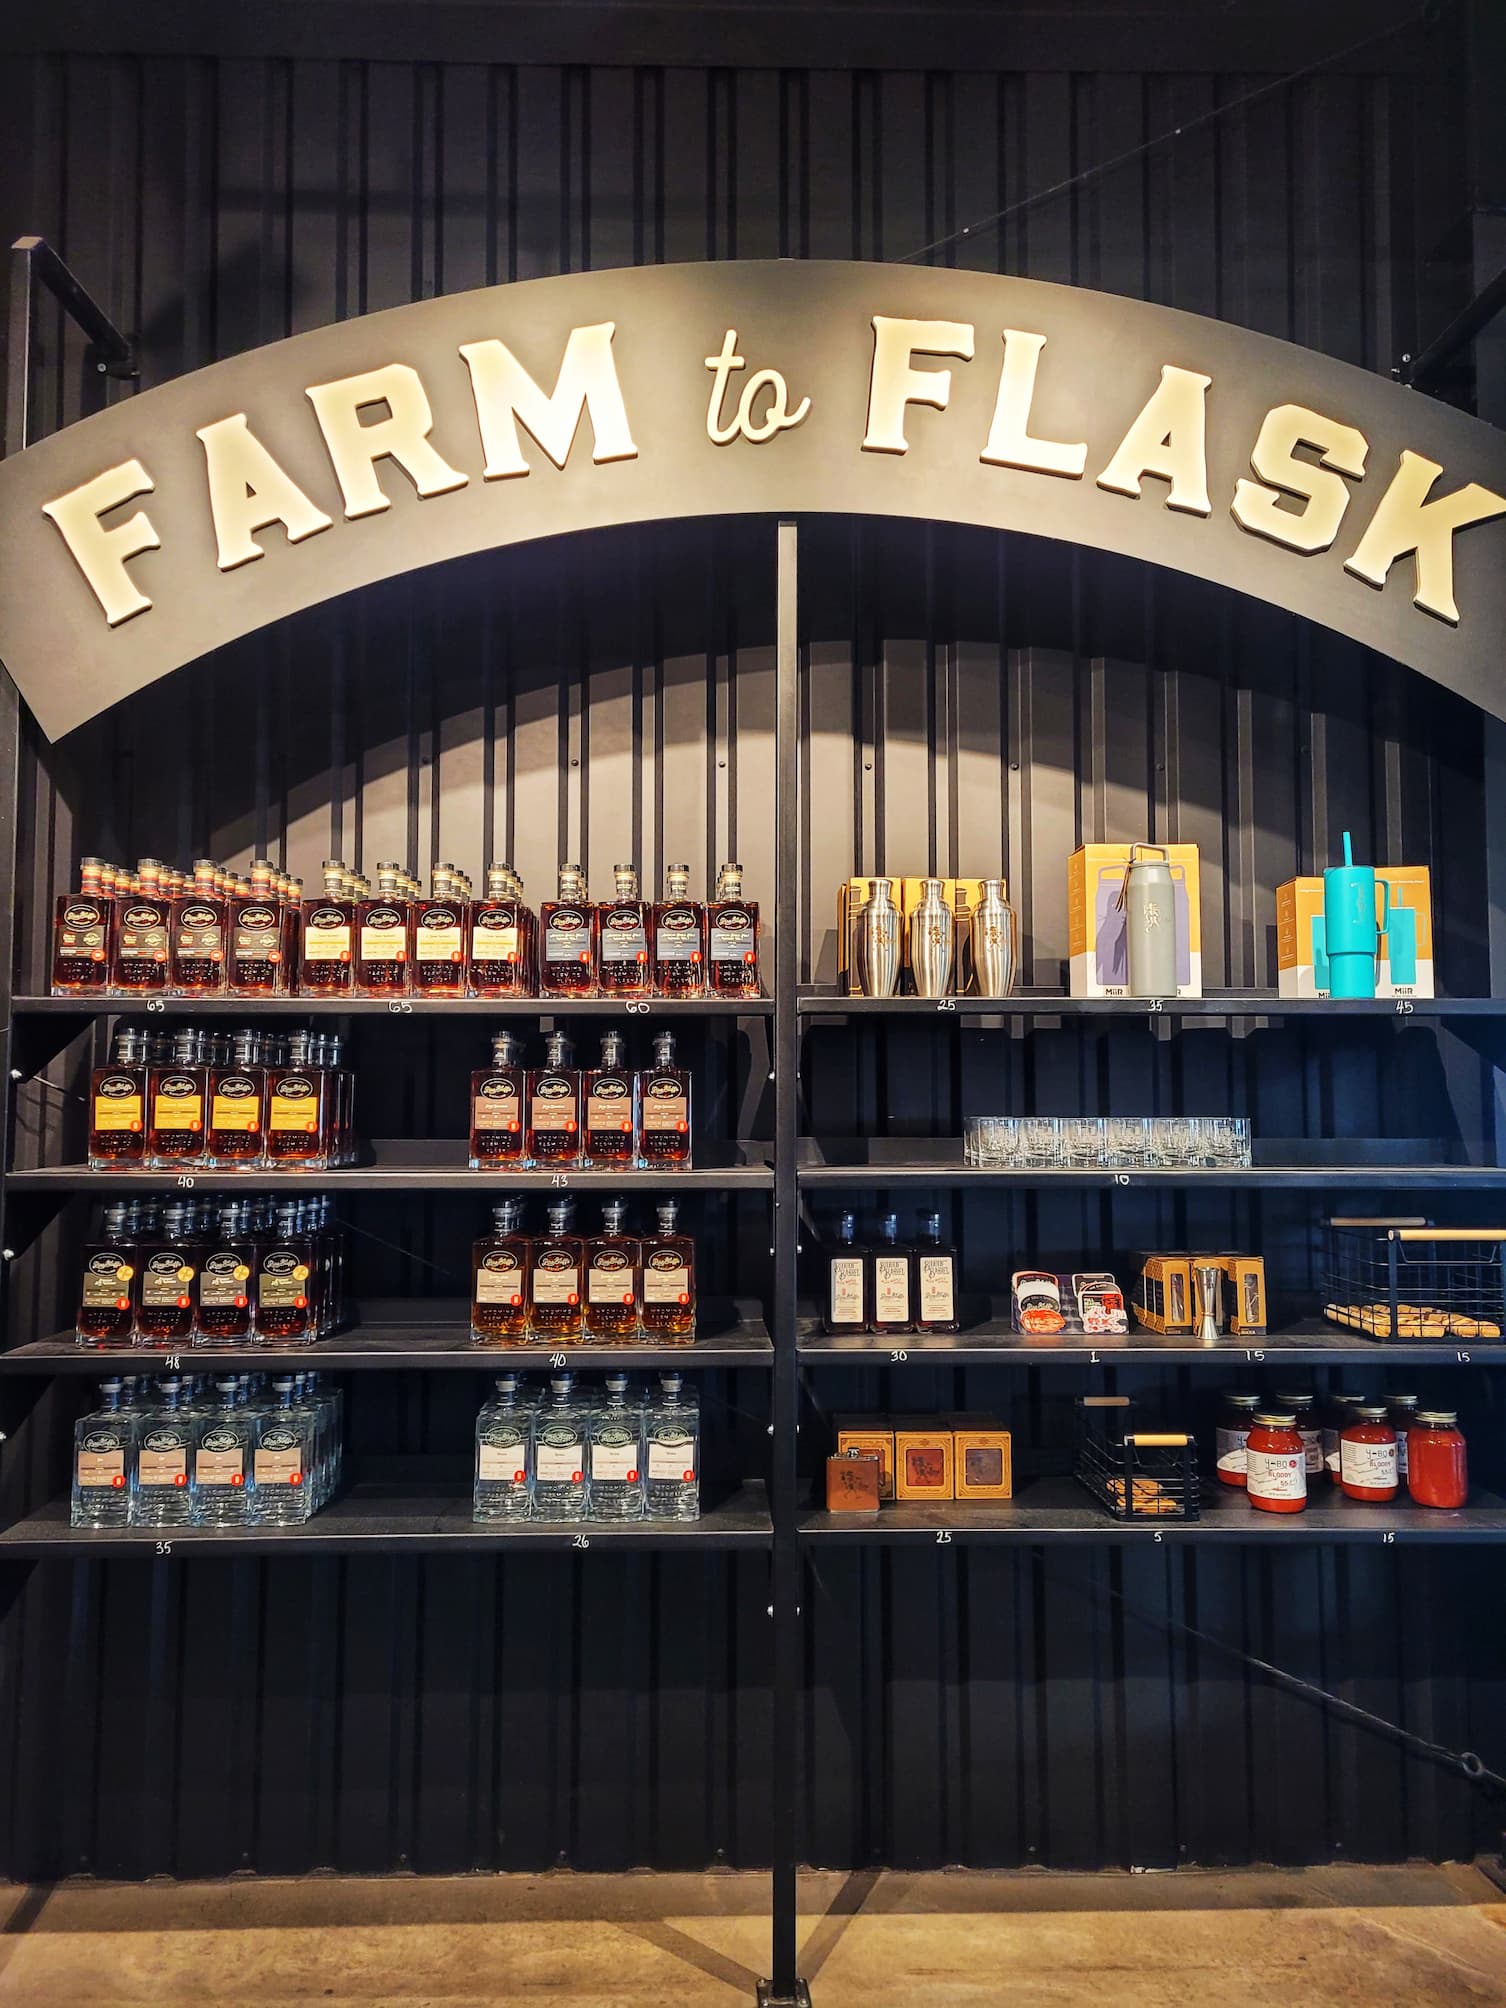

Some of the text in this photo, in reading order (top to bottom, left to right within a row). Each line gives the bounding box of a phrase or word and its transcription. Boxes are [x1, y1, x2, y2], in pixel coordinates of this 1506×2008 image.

[42, 315, 1506, 627] FARM to FLASK
[1394, 987, 1414, 995] MiiR
[147, 1000, 165, 1012] 65
[389, 1000, 413, 1013] 65
[625, 1001, 650, 1014] 60
[937, 1000, 956, 1011] 25
[1147, 999, 1163, 1011] 35
[1396, 1000, 1414, 1014] 45
[177, 1176, 194, 1188] 40
[551, 1175, 568, 1188] 43
[1114, 1174, 1130, 1185] 10
[549, 1353, 567, 1368] 40
[890, 1351, 907, 1362] 30
[1245, 1350, 1265, 1361] 15
[1456, 1351, 1471, 1362] 15
[165, 1355, 180, 1370] 48
[572, 1534, 590, 1548] 26
[936, 1531, 953, 1543] 25
[1153, 1532, 1163, 1542] 5
[1382, 1532, 1396, 1543] 15
[155, 1540, 173, 1554] 35
